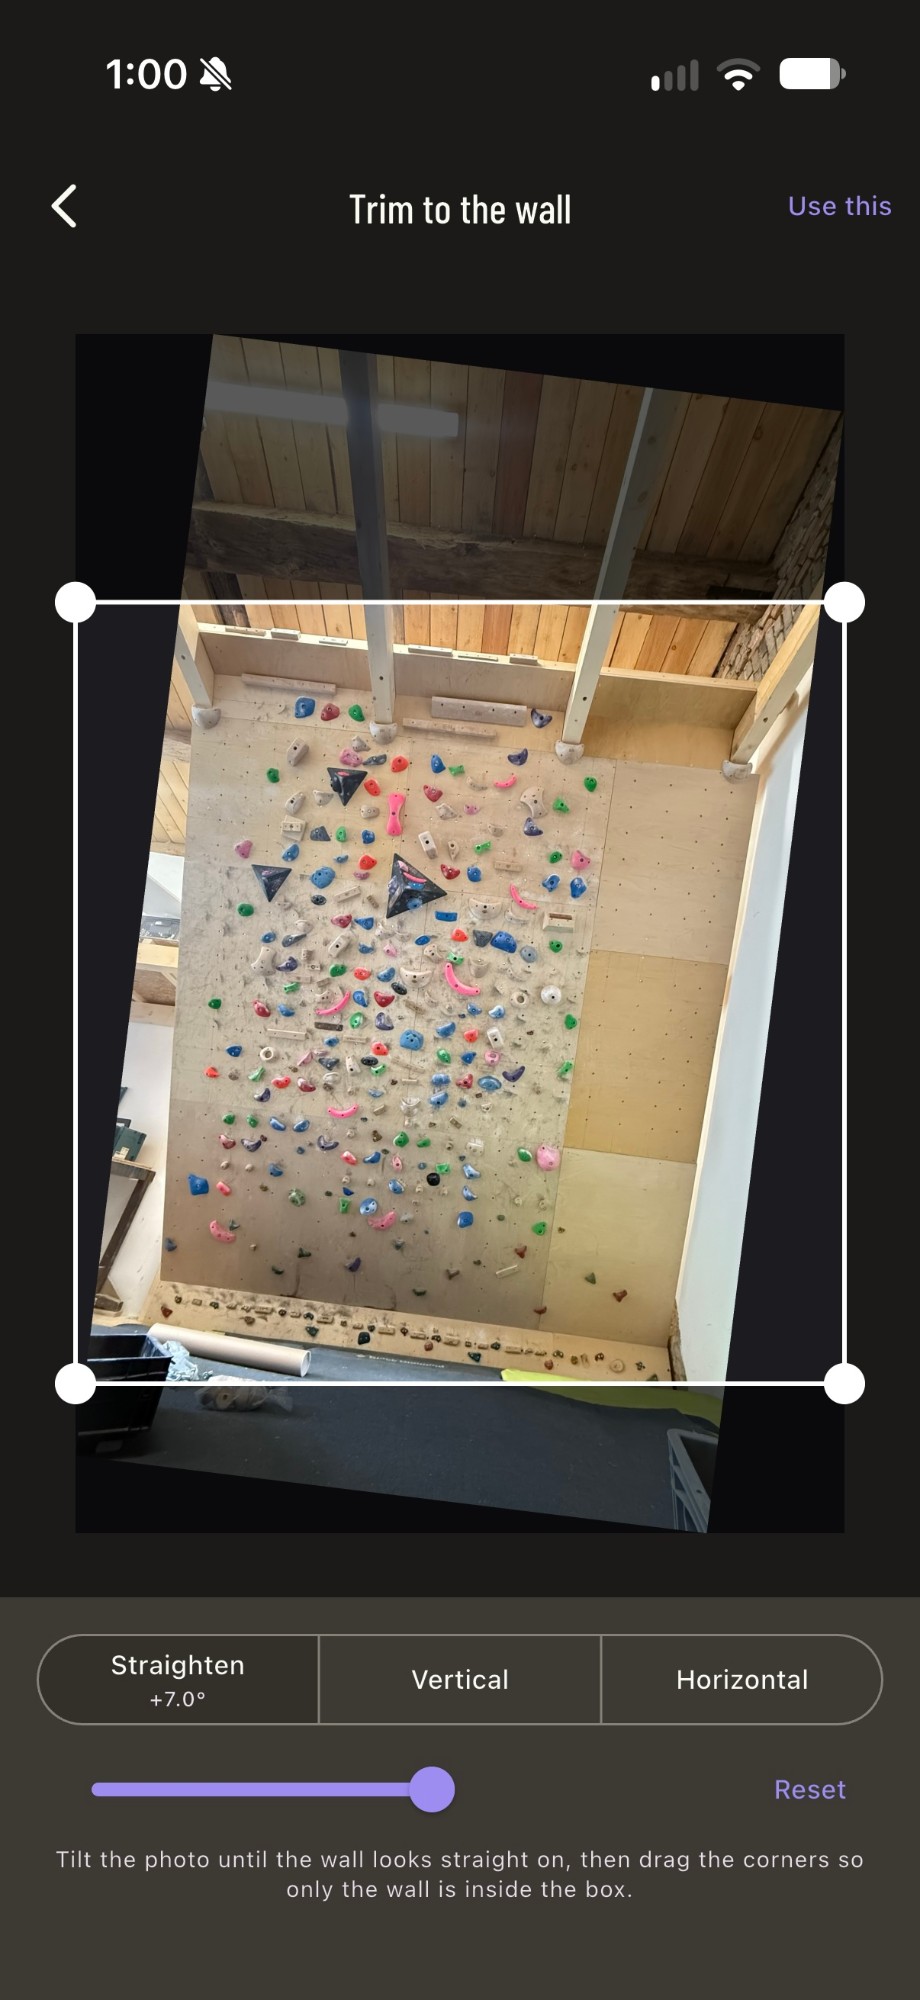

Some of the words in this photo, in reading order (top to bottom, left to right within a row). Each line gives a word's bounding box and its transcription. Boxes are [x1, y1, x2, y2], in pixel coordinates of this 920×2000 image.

[107, 58, 187, 89] 1:00
[349, 194, 413, 224] Trim
[423, 197, 450, 224] to
[460, 194, 505, 224] the
[515, 194, 570, 224] wall
[788, 196, 836, 217] Use
[845, 195, 892, 217] this
[111, 1654, 244, 1680] Straighten
[411, 1669, 508, 1690] Vertical
[677, 1669, 808, 1690] Horizontal
[150, 1691, 206, 1708] +7.0°
[775, 1779, 847, 1800] Reset
[56, 1850, 92, 1868] Tilt
[100, 1850, 136, 1868] the
[145, 1850, 210, 1872] photo
[218, 1850, 267, 1868] until
[276, 1850, 312, 1868] the
[320, 1850, 363, 1868] wall
[373, 1850, 432, 1868] looks
[441, 1850, 529, 1872] straight
[537, 1854, 571, 1872] on,
[580, 1850, 630, 1868] then
[639, 1850, 690, 1872] drag
[699, 1850, 735, 1868] the
[743, 1854, 830, 1868] corners
[838, 1854, 864, 1868] so
[286, 1880, 333, 1902] only
[342, 1880, 378, 1898] the
[386, 1880, 429, 1898] wall
[438, 1880, 456, 1898] is
[465, 1880, 532, 1898] inside
[541, 1880, 577, 1898] the
[585, 1880, 632, 1898] box.
